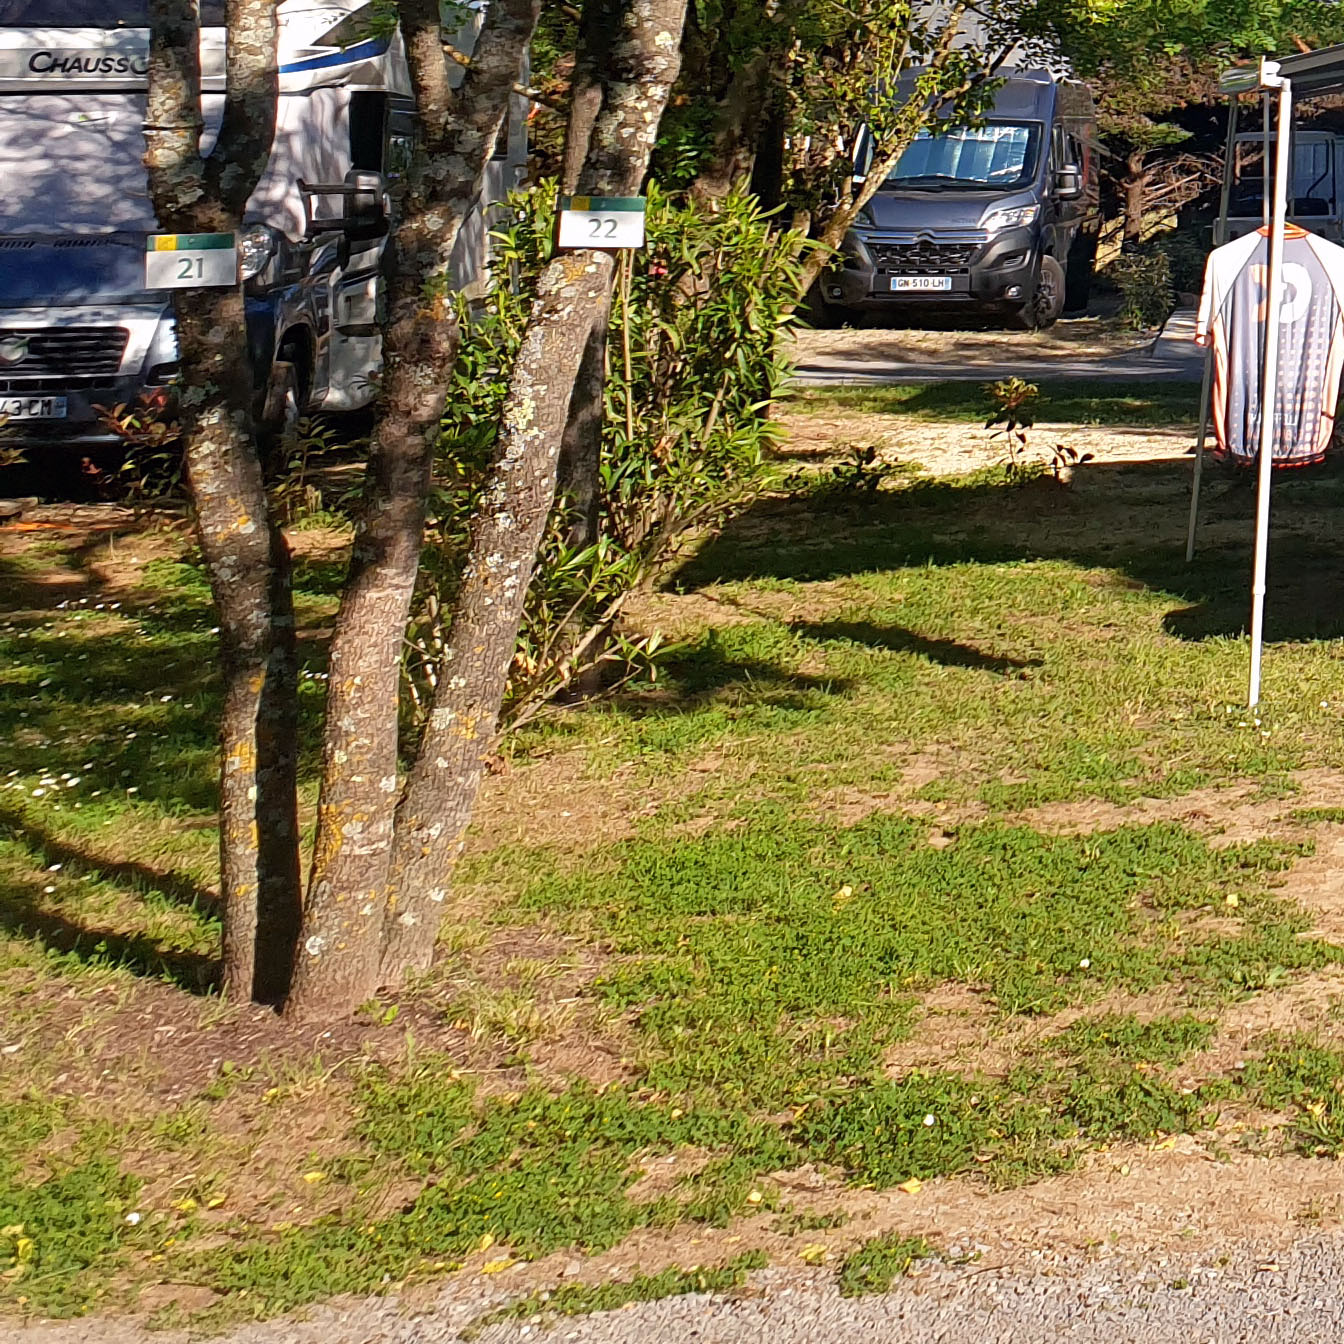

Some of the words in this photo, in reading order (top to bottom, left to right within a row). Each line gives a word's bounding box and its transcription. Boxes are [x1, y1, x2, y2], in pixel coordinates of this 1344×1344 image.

[28, 50, 149, 75] CHAUSSO
[588, 218, 618, 239] 22
[177, 257, 204, 280] 21
